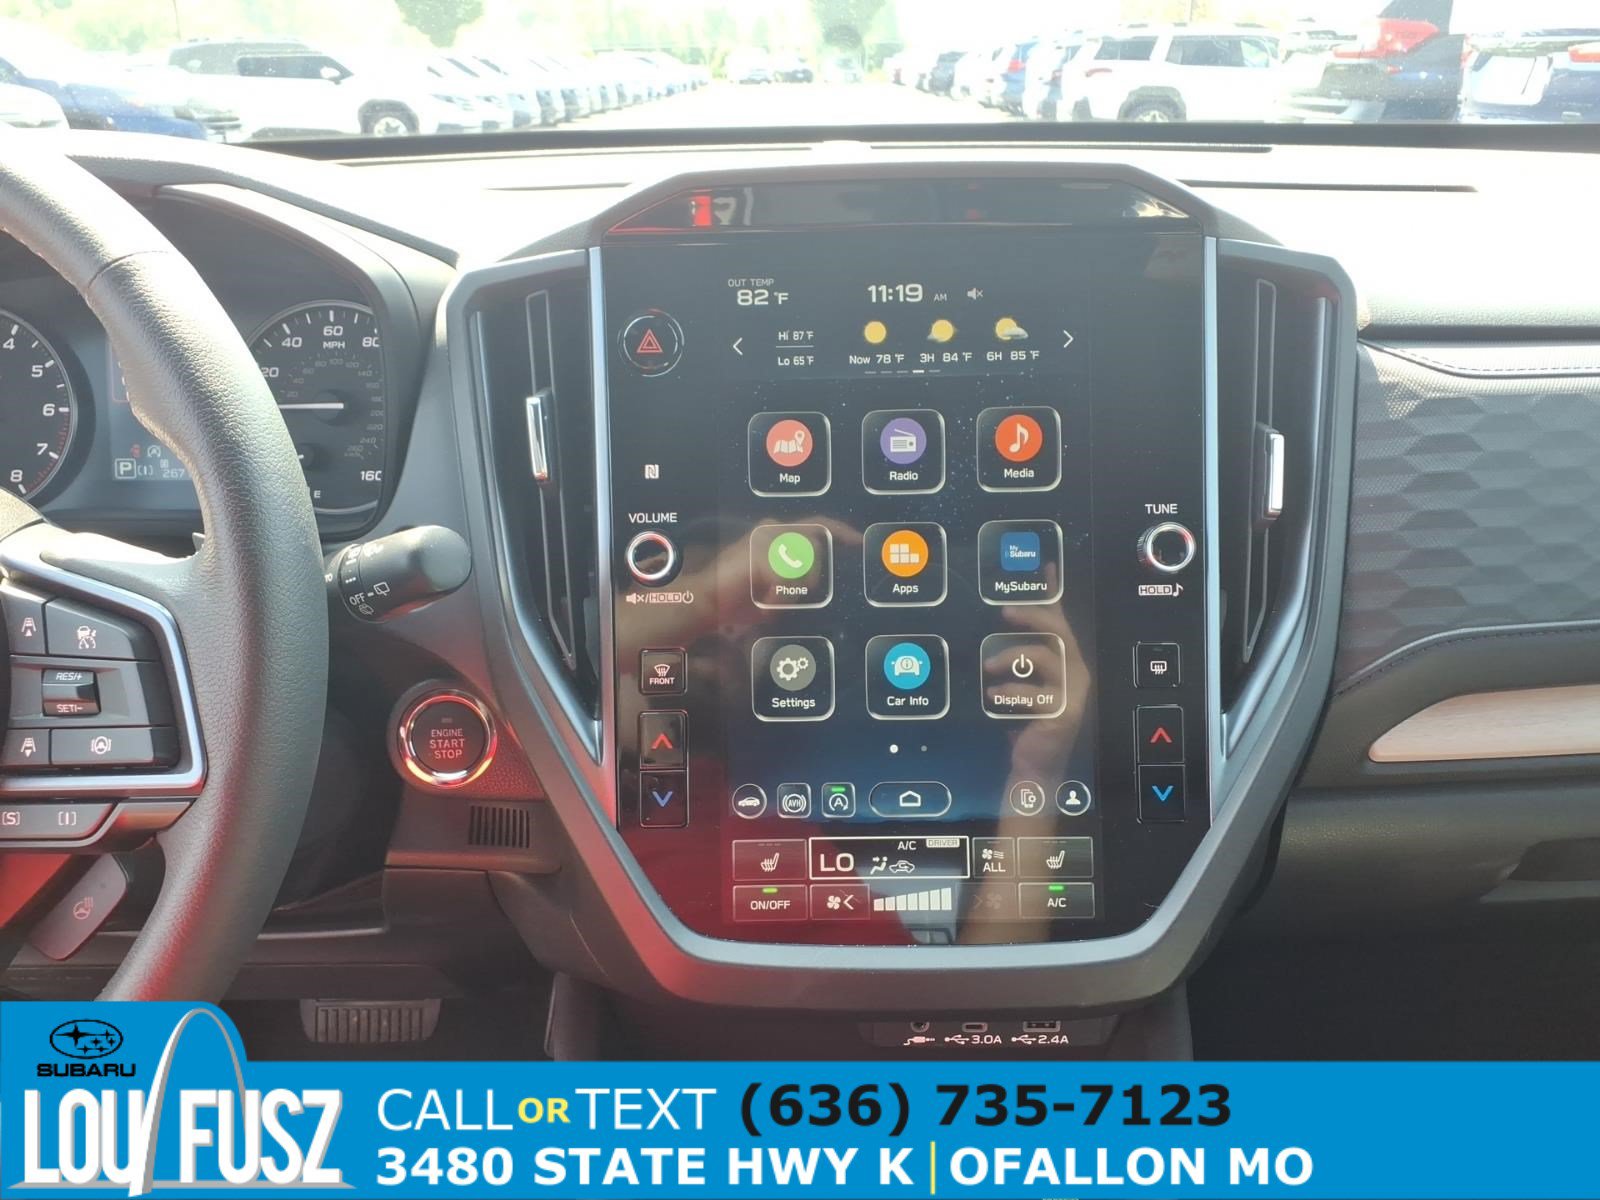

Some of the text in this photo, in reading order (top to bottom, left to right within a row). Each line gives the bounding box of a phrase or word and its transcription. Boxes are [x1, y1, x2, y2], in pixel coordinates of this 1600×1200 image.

[728, 278, 774, 287] OUT TEMP
[736, 289, 769, 305] 82
[867, 283, 923, 303] 11:19
[933, 293, 947, 302] AM
[323, 326, 343, 336] 60
[778, 331, 789, 341] Hi
[2, 337, 15, 350] 4
[281, 337, 302, 348] 40
[323, 341, 345, 349] MPH
[777, 357, 790, 366] Lo
[849, 354, 871, 365] Now
[875, 354, 892, 364] 78
[919, 353, 935, 363] 3H
[942, 352, 959, 362] 84
[986, 351, 1003, 361] 6H
[1010, 351, 1027, 361] 85
[31, 365, 43, 377] 5
[260, 367, 280, 378] 20
[43, 403, 55, 416] 6
[36, 444, 48, 455] 7
[119, 461, 133, 476] P
[1003, 467, 1035, 480] Media
[10, 469, 22, 482] 8
[778, 472, 801, 485] Map
[888, 470, 919, 482] Radio
[314, 490, 321, 498] E
[1145, 503, 1178, 515] TUNE
[628, 512, 678, 524] VOLUME
[776, 584, 808, 596] Phone
[891, 582, 920, 595] Apps
[995, 581, 1048, 594] MySubaru
[1140, 585, 1170, 595] HOLD
[349, 592, 365, 605] OFF
[651, 593, 680, 602] HOLD
[649, 676, 675, 686] FRONT
[771, 696, 816, 710] Settings
[886, 694, 930, 707] Car Info
[994, 692, 1054, 706] Display Off
[431, 729, 463, 737] ENGINE
[430, 739, 465, 748] START
[434, 750, 462, 759] STOP
[897, 841, 917, 852] A/C
[928, 839, 959, 847] DRIVER
[820, 853, 854, 872] LO
[983, 862, 1005, 873] ALL
[750, 899, 791, 910] ON/OFF
[1047, 897, 1067, 908] A/C
[971, 1034, 1002, 1045] 3.0A
[1038, 1034, 1069, 1045] 2.4A
